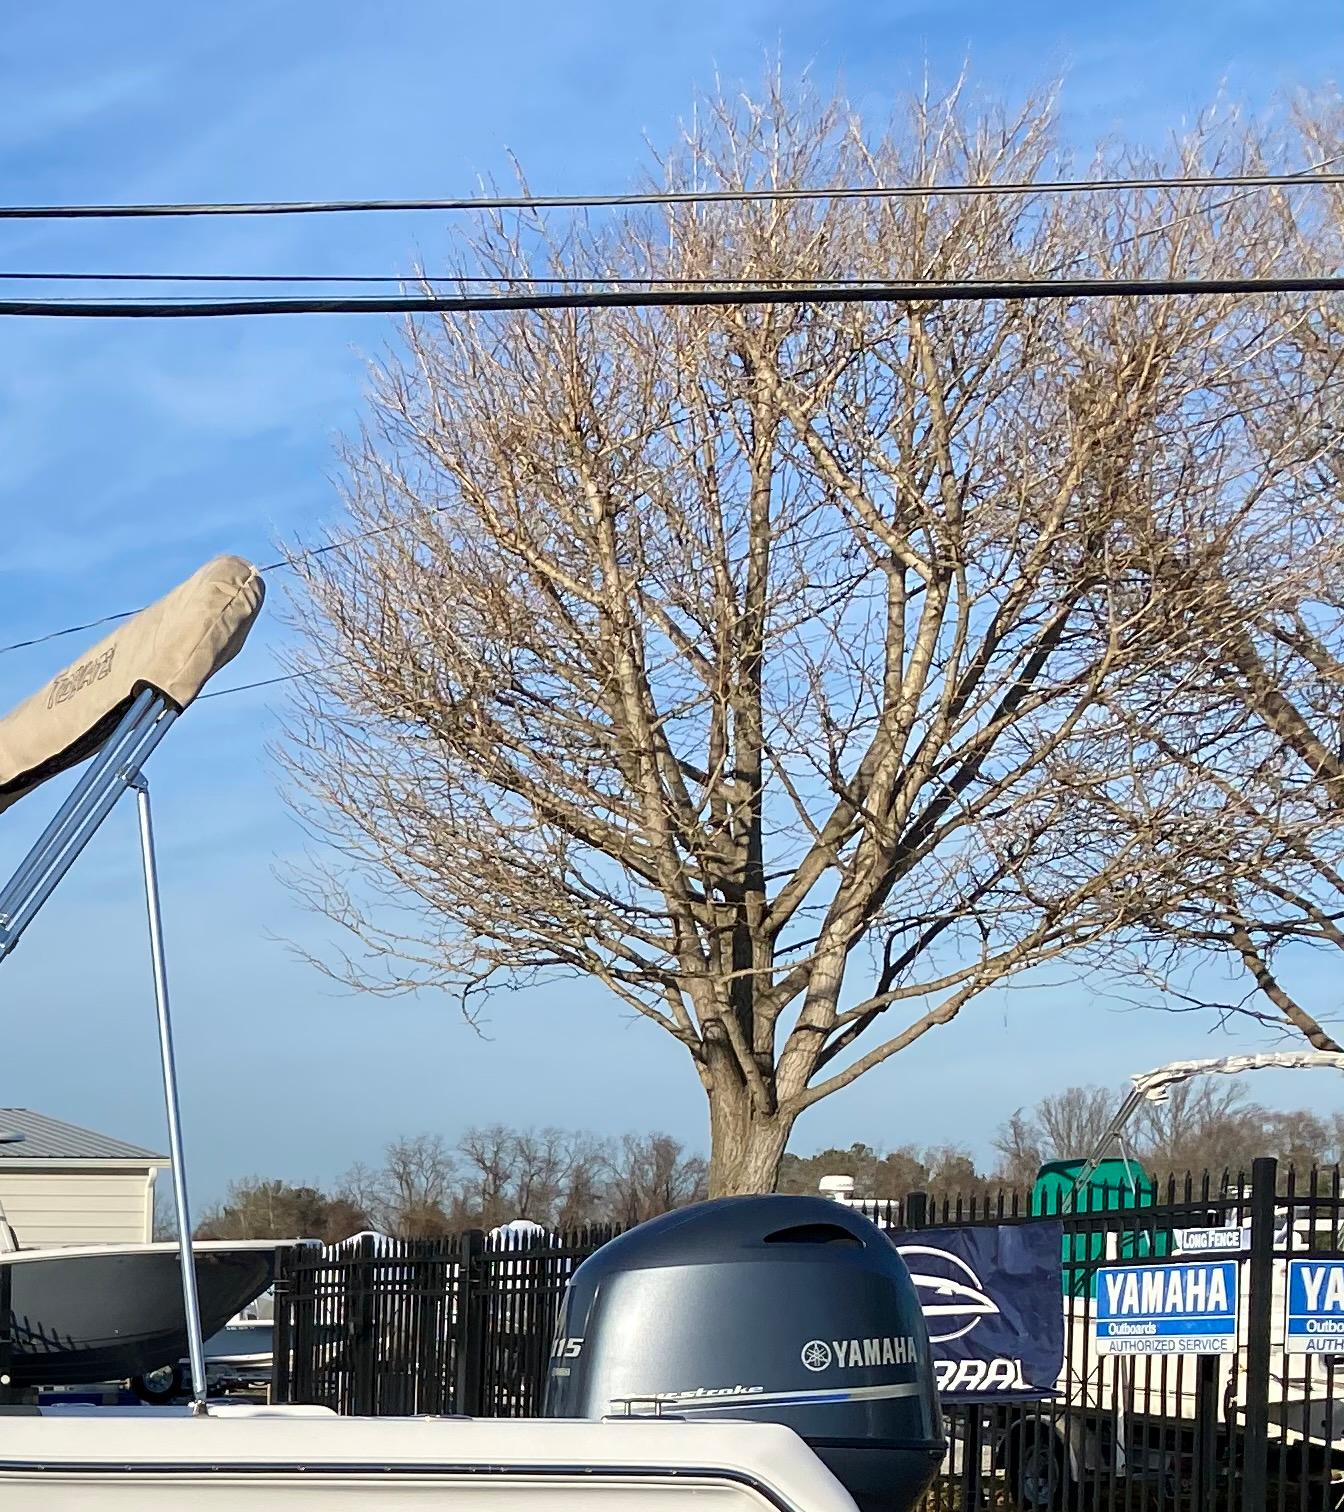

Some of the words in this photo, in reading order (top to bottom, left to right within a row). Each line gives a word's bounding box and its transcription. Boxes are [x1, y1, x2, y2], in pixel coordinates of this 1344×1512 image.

[1184, 1231, 1208, 1248] LONG
[1208, 1230, 1240, 1247] FENCE
[1105, 1267, 1228, 1315] YAMAHA
[1108, 1322, 1157, 1336] Outboards
[833, 1337, 917, 1368] YAMAHA
[1109, 1339, 1176, 1352] AUTHORIZED
[1178, 1338, 1228, 1351] SERVICE
